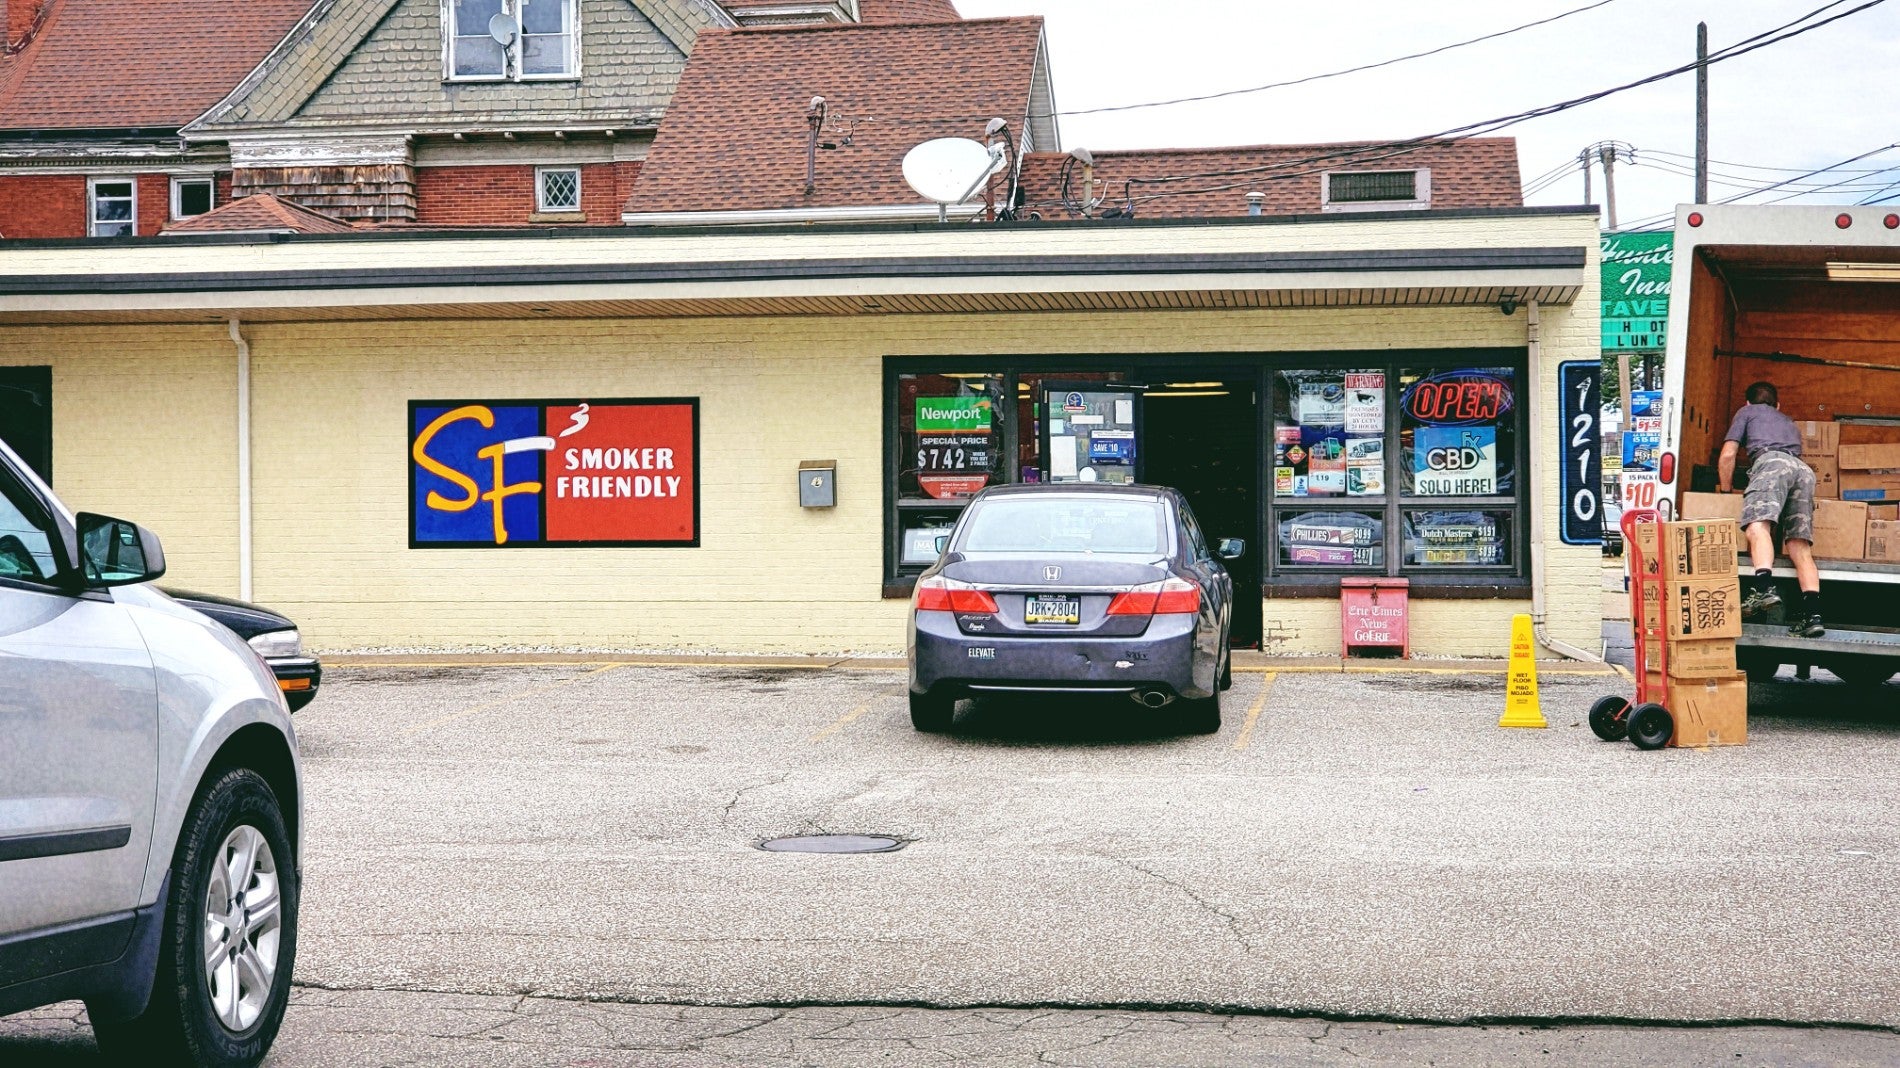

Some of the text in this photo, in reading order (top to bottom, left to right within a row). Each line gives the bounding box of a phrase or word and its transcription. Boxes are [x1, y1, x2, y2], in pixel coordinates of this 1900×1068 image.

[1600, 238, 1673, 264] Hunte
[1601, 300, 1668, 315] TAVE
[1347, 375, 1383, 388] WARNING
[1413, 383, 1502, 418] OPEN
[921, 407, 981, 422] Newport
[922, 437, 988, 446] SPECIAL PRICE
[1093, 443, 1107, 452] SAVE
[565, 447, 675, 470] SMOKER
[917, 448, 965, 469] $7.42
[1427, 447, 1479, 471] CBD
[557, 475, 682, 498] FRIENDLY
[1420, 478, 1492, 494] SOLD HERE!
[1626, 482, 1655, 508] $10
[1296, 529, 1328, 542] PHILLIES
[1421, 529, 1443, 537] Dutch
[1444, 529, 1473, 537] Masters
[1681, 593, 1690, 608] 16
[1348, 605, 1403, 616] Erie Times
[1695, 590, 1711, 629] CROSS
[1360, 617, 1388, 629] News
[968, 648, 996, 659] ELEVATE
